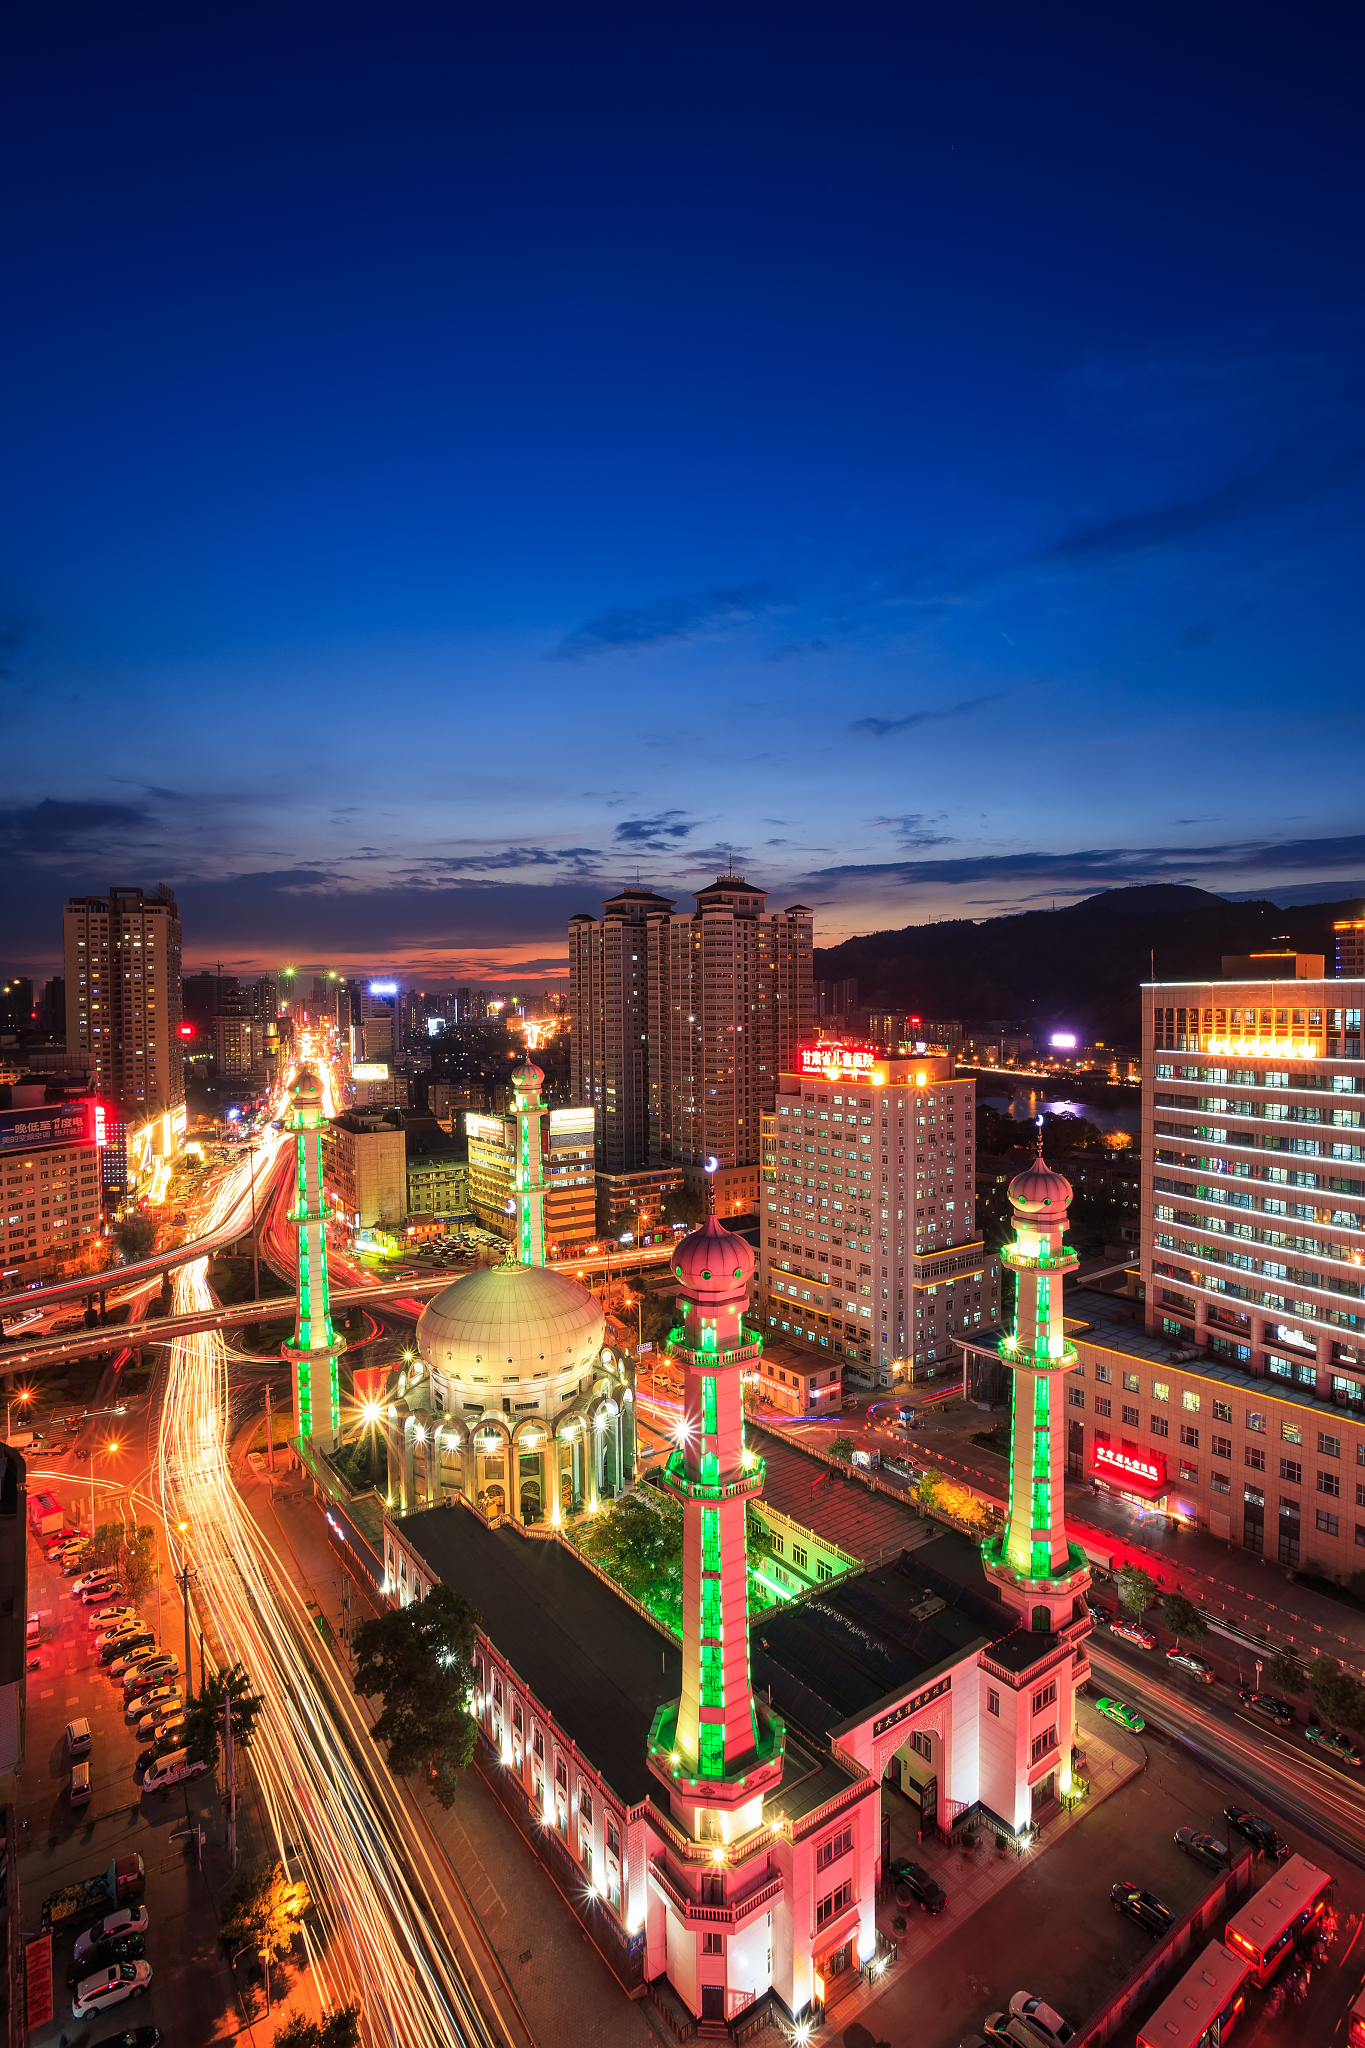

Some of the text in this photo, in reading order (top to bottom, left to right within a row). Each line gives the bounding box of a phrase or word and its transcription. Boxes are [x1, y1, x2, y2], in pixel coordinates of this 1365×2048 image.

[802, 1050, 875, 1068] 甘肃省儿童医院
